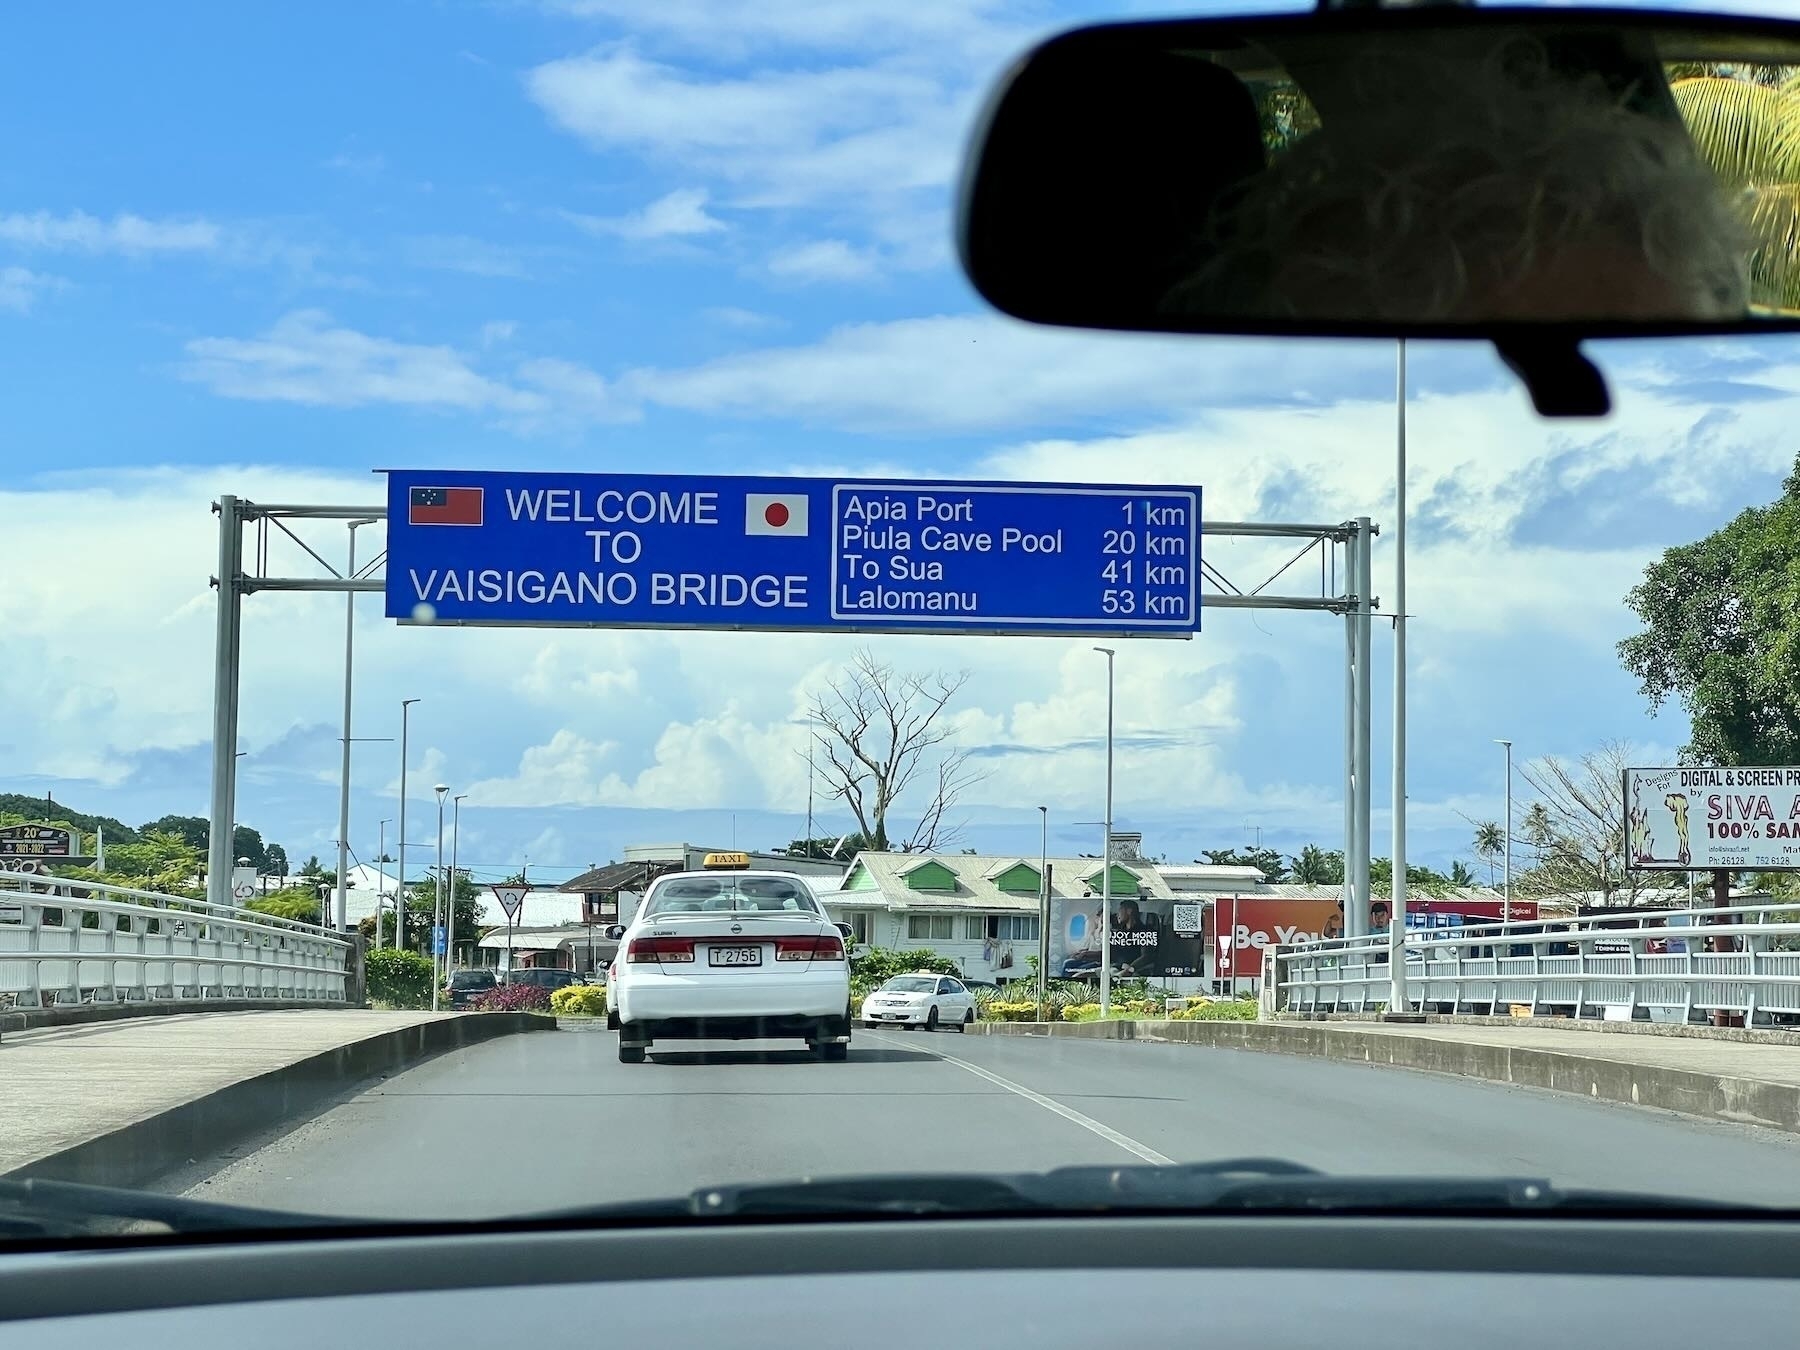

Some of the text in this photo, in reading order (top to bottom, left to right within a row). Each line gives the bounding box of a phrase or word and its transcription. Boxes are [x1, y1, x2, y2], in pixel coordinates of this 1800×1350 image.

[504, 488, 720, 525] WELCOME
[843, 495, 1186, 527] Apia Port 1 km
[584, 530, 642, 564] TO
[842, 525, 1186, 556] Piula Cave Pool 20 km
[842, 554, 1186, 586] To Sua 41 km
[408, 568, 810, 609] VAISIGANO BRIDGE
[842, 584, 1186, 615] Lalomanu 53 km
[1645, 769, 1679, 787] Designs
[1656, 782, 1671, 792] For
[1681, 770, 1723, 787] DIGITAL
[1725, 771, 1735, 787] &
[1737, 770, 1783, 787] SCREEN
[1690, 788, 1703, 798] by
[1707, 794, 1775, 821] SIVA
[1707, 822, 1760, 839] 100%
[712, 854, 742, 863] TAXI
[1708, 856, 1720, 865] Ph:
[1755, 856, 1770, 865] 752
[1132, 931, 1158, 939] MORE
[1233, 924, 1270, 949] Be
